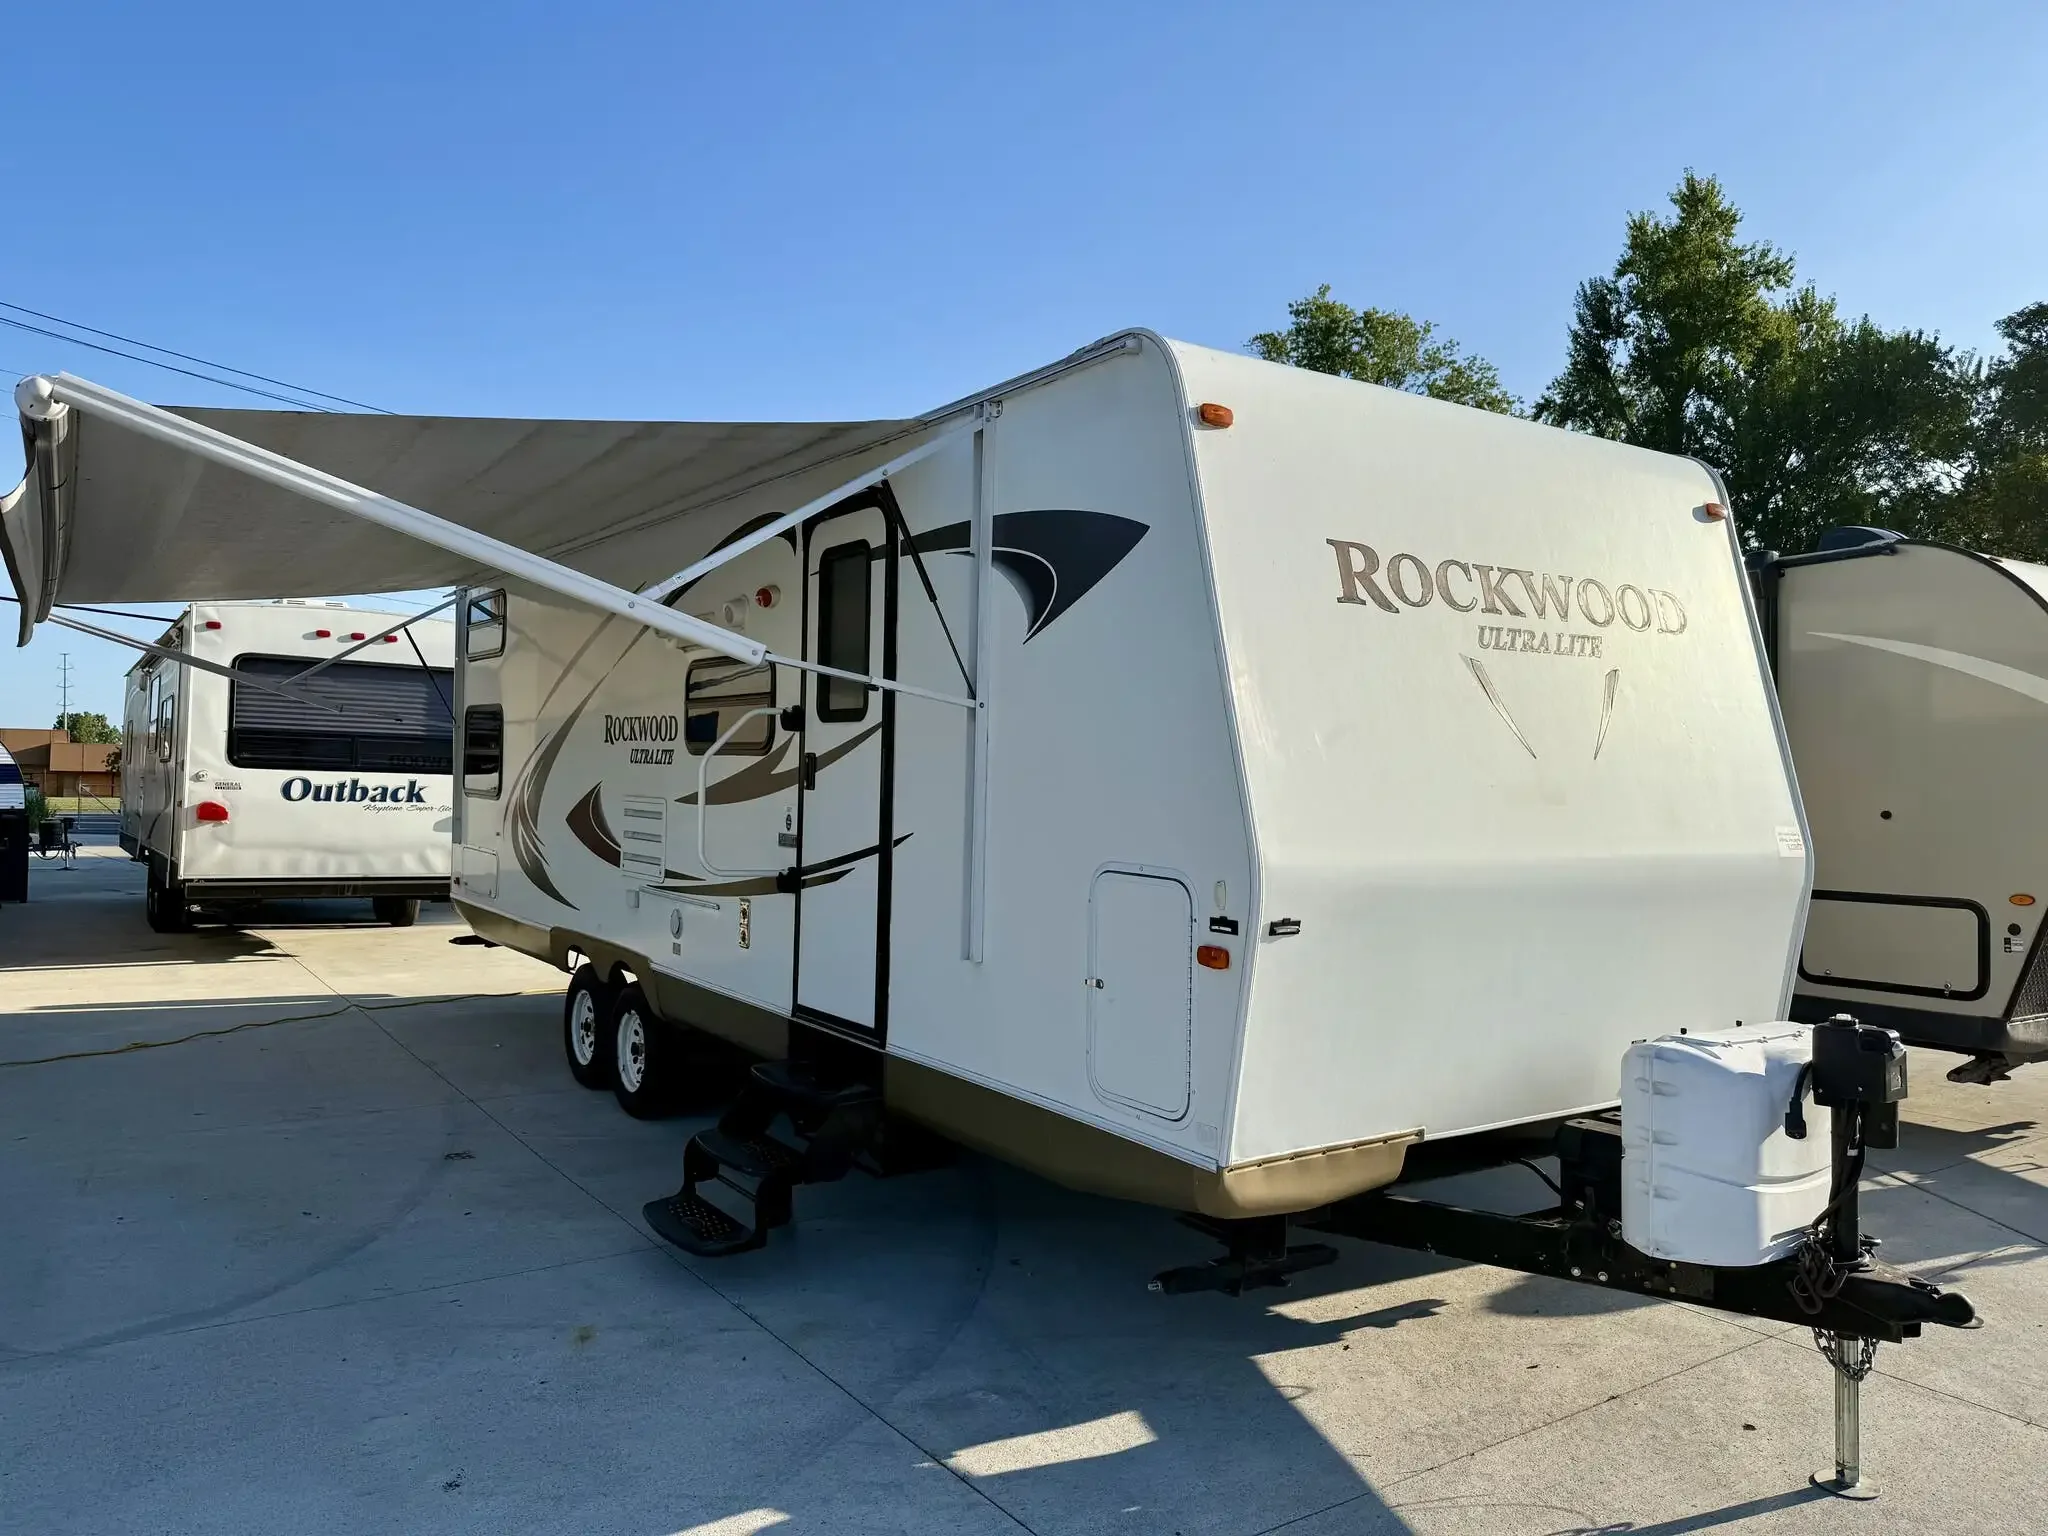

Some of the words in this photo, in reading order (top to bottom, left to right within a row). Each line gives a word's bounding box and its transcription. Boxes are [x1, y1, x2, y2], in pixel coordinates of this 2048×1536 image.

[1326, 538, 1688, 635] ROCKWOOD
[603, 714, 679, 745] ROCKWOOD
[279, 775, 429, 804] Outback
[363, 804, 403, 815] Keystone
